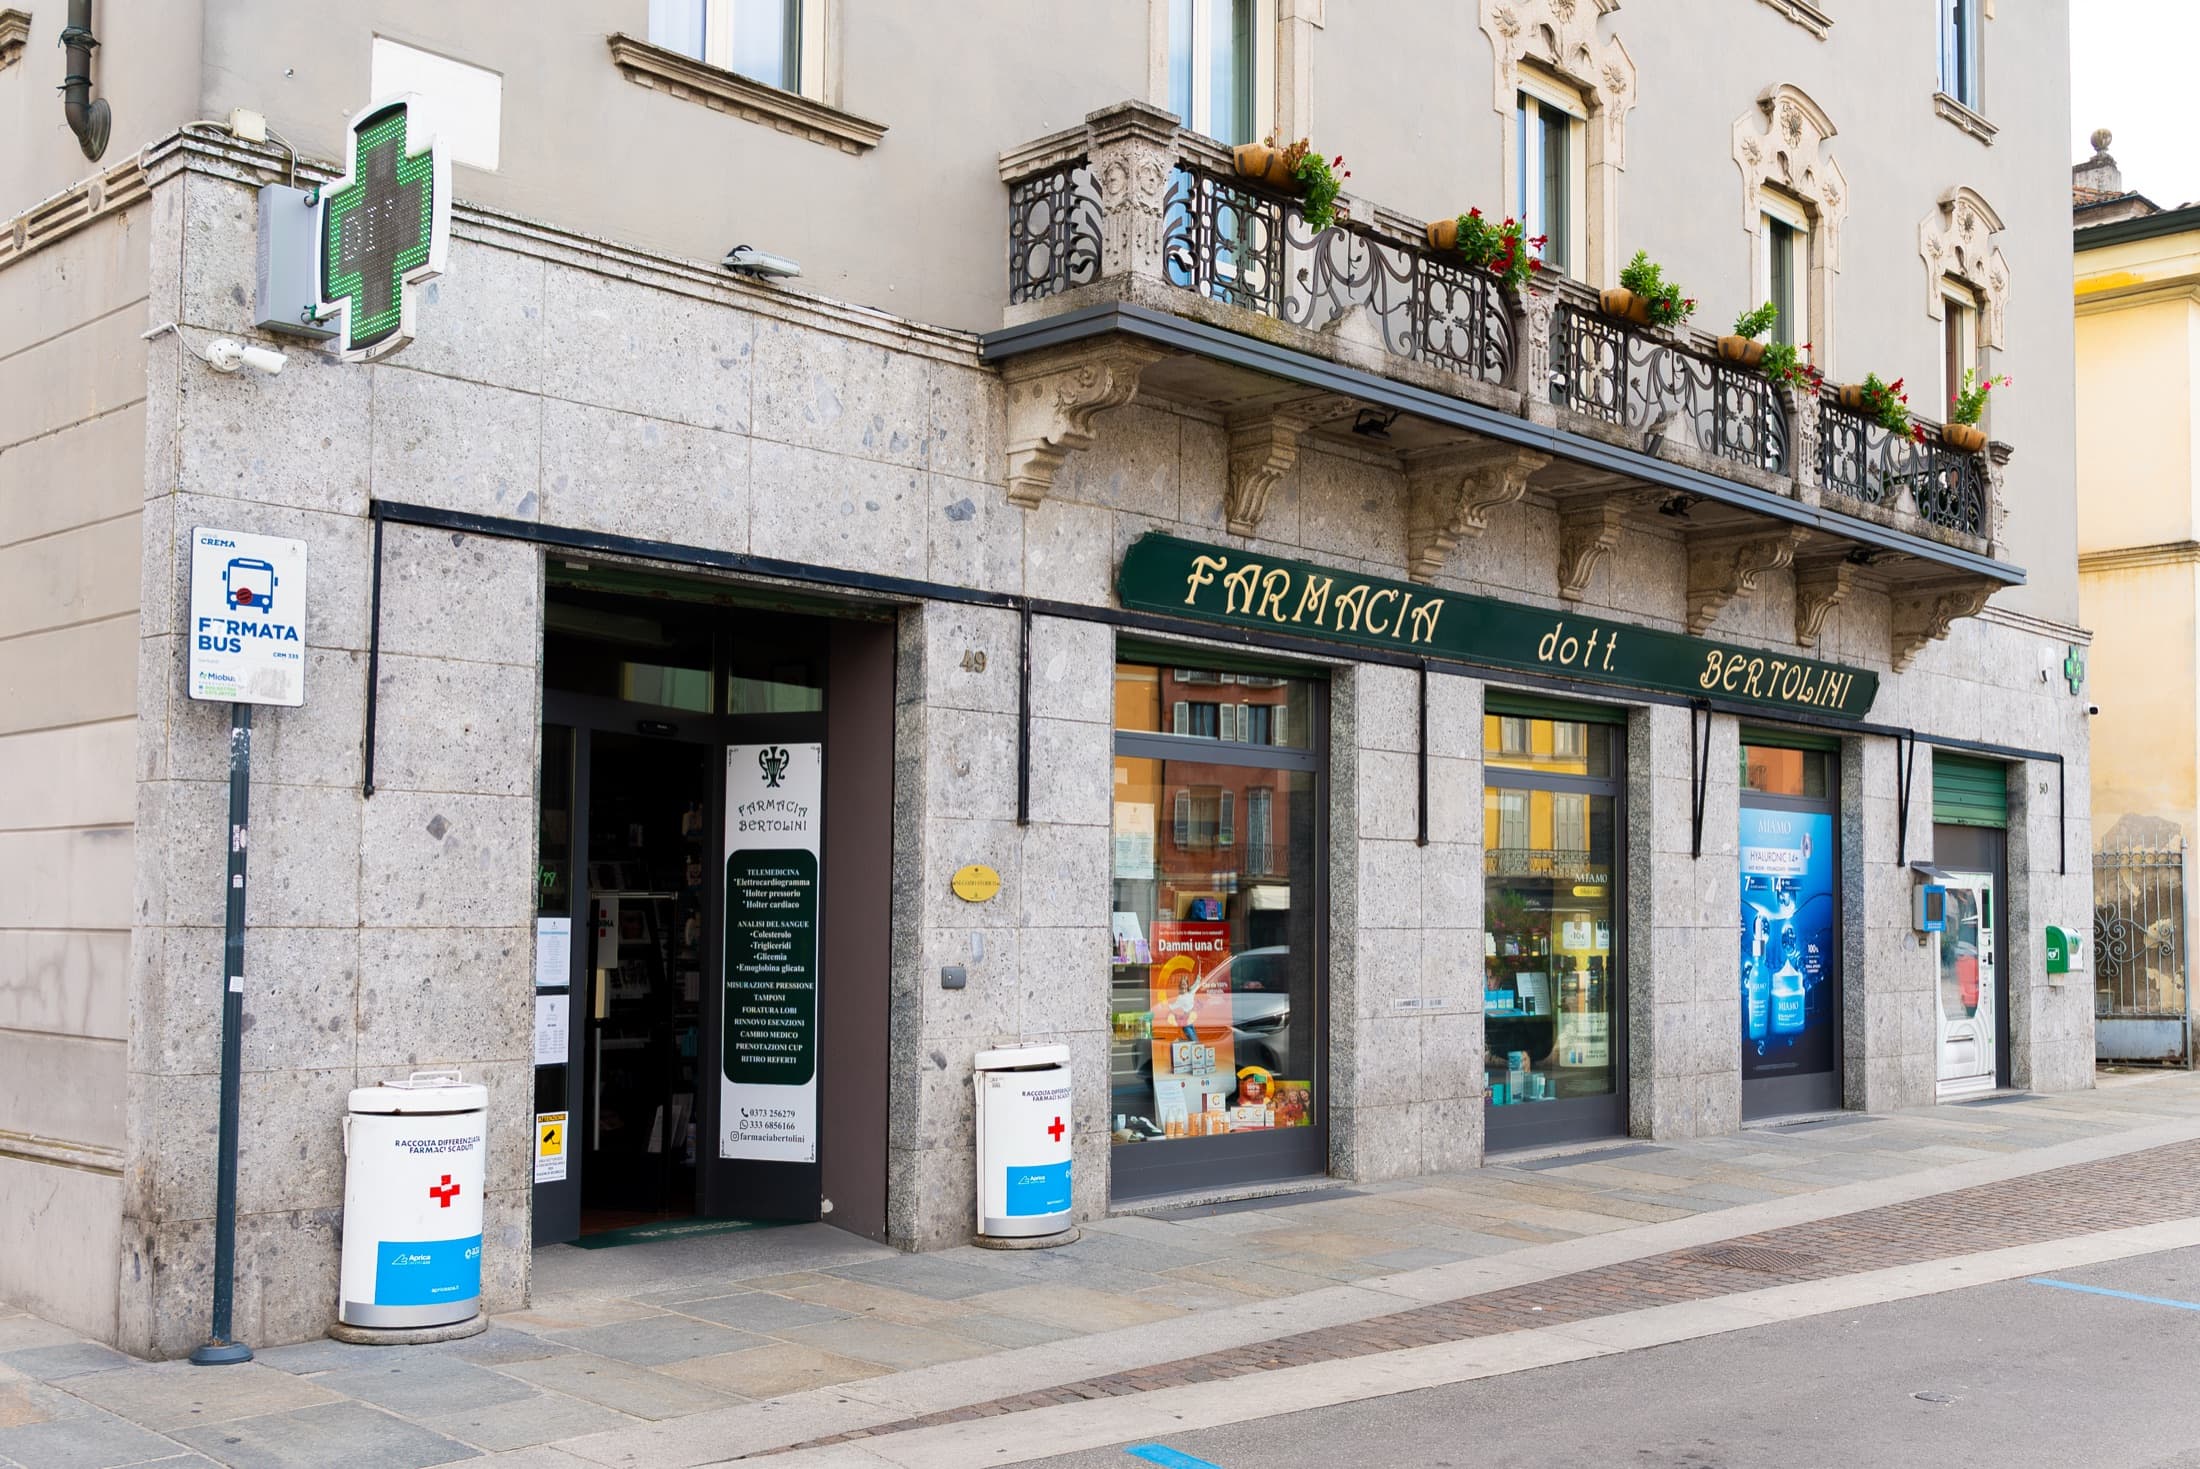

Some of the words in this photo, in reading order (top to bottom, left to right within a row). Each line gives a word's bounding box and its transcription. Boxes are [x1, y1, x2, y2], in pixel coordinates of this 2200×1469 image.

[200, 537, 236, 548] CREMA
[199, 617, 299, 641] FRMATA
[1184, 555, 1445, 644] FARMACIA
[1538, 621, 1618, 673] dott.
[1700, 650, 1854, 709] BERTOLINI
[198, 635, 242, 653] BUS
[959, 649, 987, 674] 49
[738, 799, 808, 818] FARMACIA
[738, 819, 807, 832] BERTOLINI
[1758, 818, 1792, 833] MIAMO
[747, 868, 800, 876] TELEMEDICINA
[1575, 873, 1608, 883] MIAMO
[768, 889, 801, 899] pressorio
[746, 900, 768, 909] Holter
[769, 900, 800, 909] cardiaco
[752, 930, 792, 939] Colesterolo
[753, 941, 792, 951] Trigliceridi
[1158, 938, 1193, 952] Dammi
[1194, 941, 1213, 952] una
[1213, 938, 1224, 951] C!
[756, 952, 788, 961] Glicemia
[739, 963, 780, 973] Emoglobina
[781, 964, 805, 974] glicata
[726, 981, 774, 989] MISURAZIONE
[775, 982, 814, 990] PRESSIONE
[754, 993, 786, 1001] TAMPONI
[742, 1006, 779, 1014] FORATURA
[734, 1018, 767, 1026] RINNOVO
[767, 1019, 805, 1027] ESENZIONI
[769, 1031, 799, 1039] MEDICO
[735, 1043, 787, 1051] PRENOTAZIONI
[788, 1044, 803, 1052] CUP
[741, 1055, 766, 1063] RITIRO
[767, 1056, 797, 1064] REFERTI
[749, 1109, 768, 1118] 0373
[769, 1109, 796, 1118] 256279
[749, 1120, 763, 1129] 333
[764, 1121, 796, 1130] 6856166
[740, 1132, 805, 1143] farmaciabertolini
[395, 1139, 436, 1147] RACCOLTA
